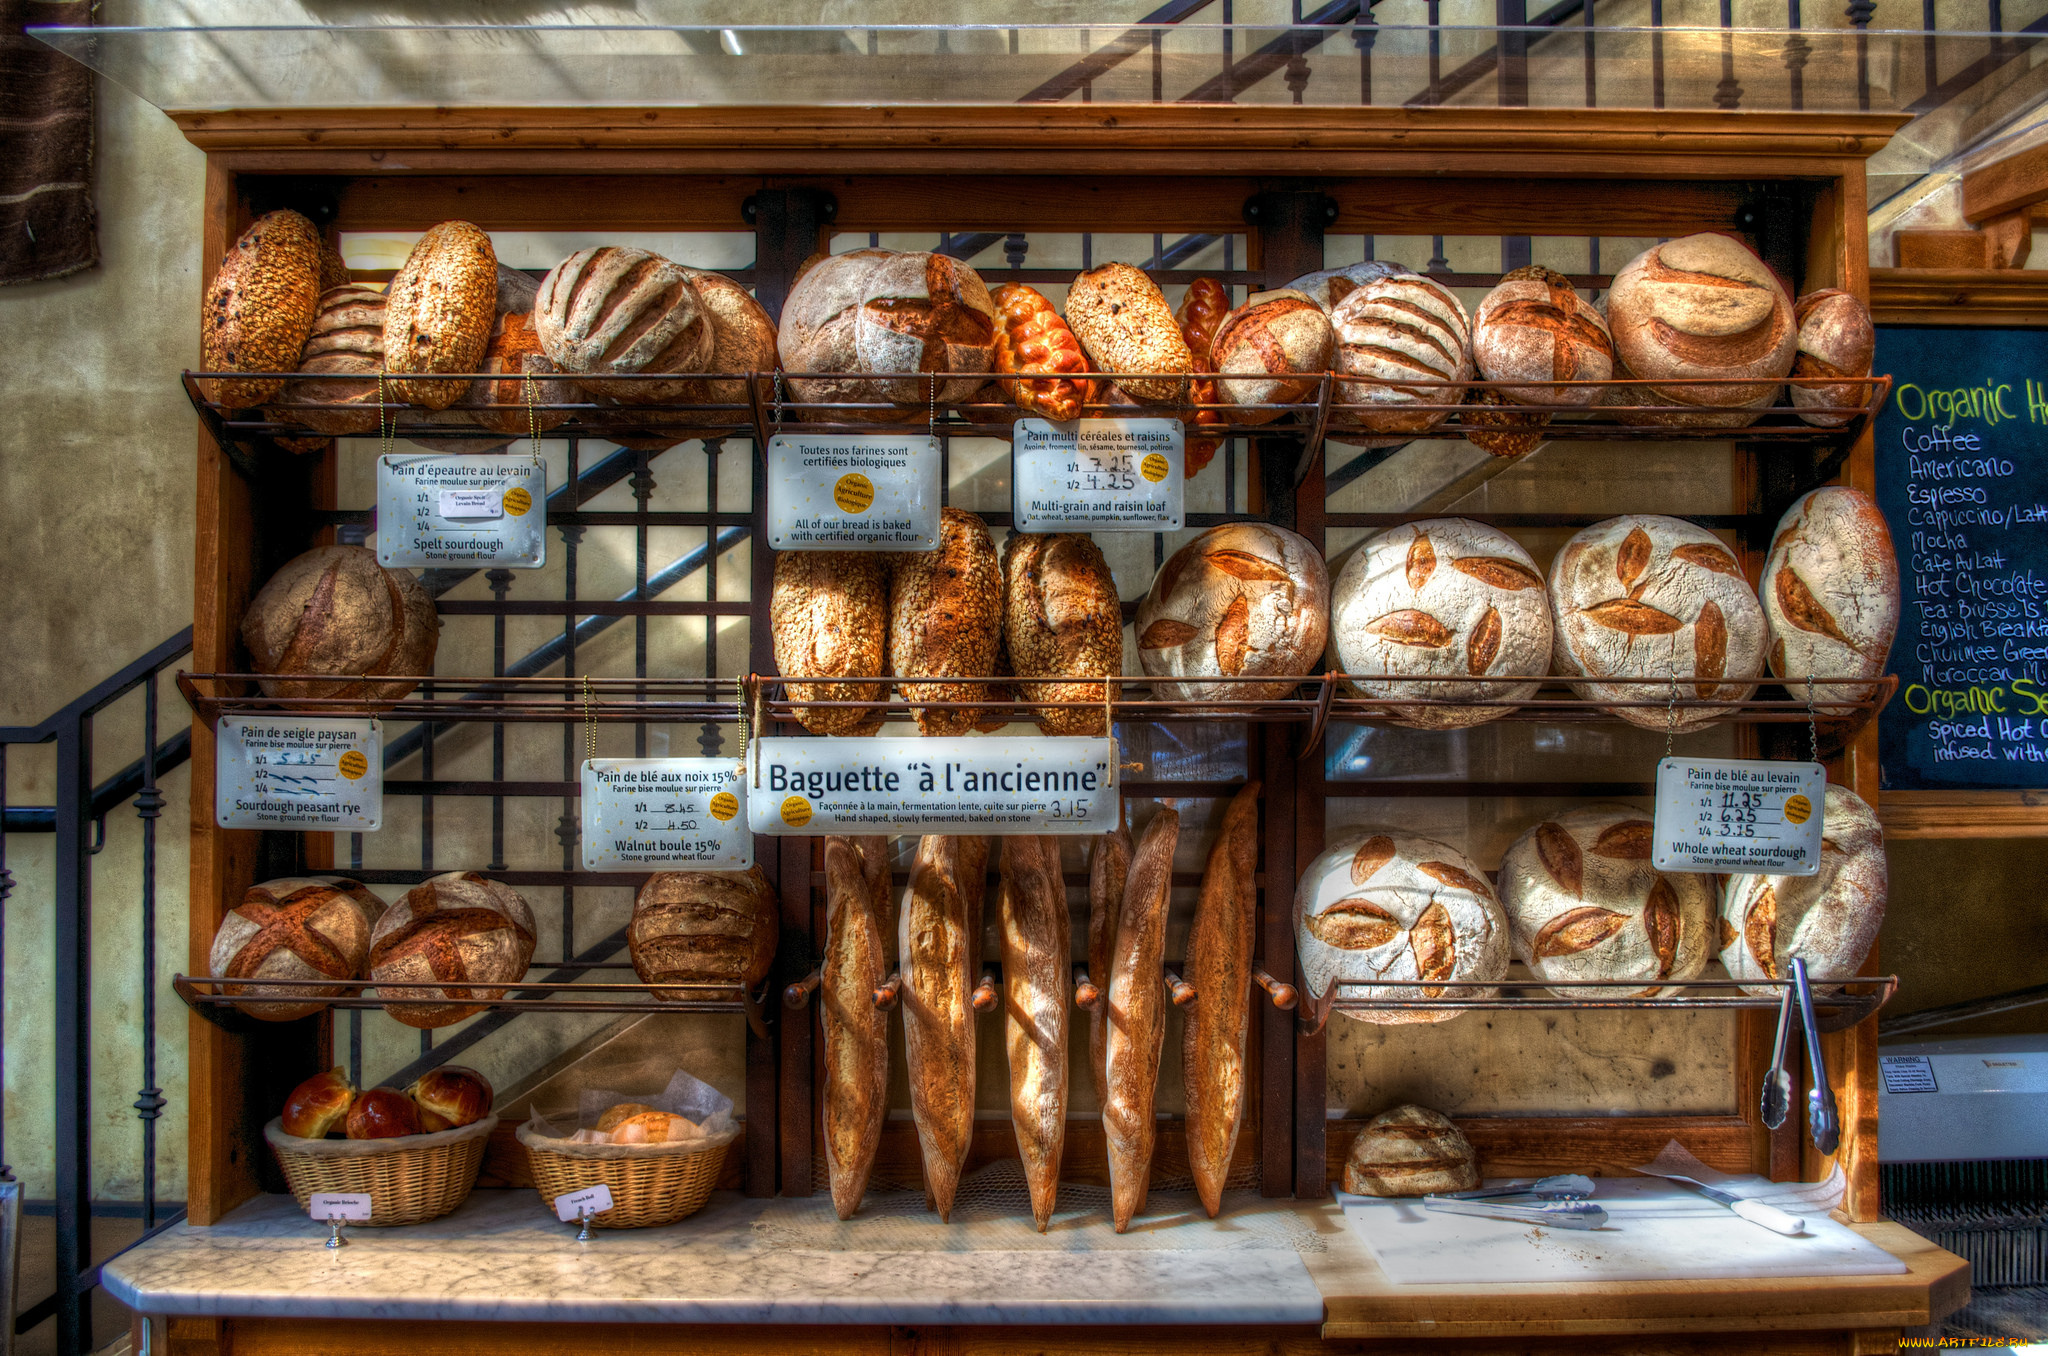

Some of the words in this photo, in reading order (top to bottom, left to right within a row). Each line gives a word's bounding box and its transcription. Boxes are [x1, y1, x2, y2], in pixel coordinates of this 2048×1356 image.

[1896, 377, 2016, 431] Organic
[1027, 432, 1048, 441] Pain
[1052, 432, 1077, 441] multi
[1080, 432, 1122, 441] céréales
[1125, 433, 1134, 441] et
[1138, 432, 1170, 441] raisins
[1902, 424, 1981, 452] Coffee
[800, 445, 830, 455] Toutes
[833, 447, 849, 455] nos
[852, 445, 885, 455] farines
[888, 447, 908, 455] sont
[803, 457, 848, 466] certifiées
[851, 457, 906, 469] biologiques
[1089, 455, 1135, 475] 7.25
[1909, 455, 2014, 480] Americano
[392, 465, 414, 475] Pain
[418, 465, 476, 478] d'épeautre
[497, 465, 530, 476] levain
[846, 479, 868, 489] Organic
[1087, 474, 1135, 490] 4.25
[417, 494, 429, 502] 1/1
[837, 487, 872, 500] Agriculture
[1907, 483, 1987, 510] Espresso
[417, 509, 430, 517] 1/2
[1032, 501, 1089, 513] Multi-grain
[1093, 501, 1111, 511] and
[1115, 501, 1143, 511] raisin
[1146, 501, 1166, 511] loaf
[1092, 514, 1121, 522] pumpkin,
[417, 523, 430, 531] 1/4
[796, 520, 808, 529] All
[812, 520, 821, 529] of
[843, 520, 869, 529] bread
[883, 520, 911, 529] baked
[791, 531, 812, 541] with
[815, 531, 855, 541] certified
[857, 532, 893, 543] organic
[896, 532, 918, 541] flour
[1911, 531, 1967, 554] Mocha
[414, 539, 442, 550] Spelt
[445, 539, 503, 552] sourdough
[449, 552, 475, 561] ground
[1911, 554, 1952, 572] Cafe
[1975, 549, 2006, 569] Lait
[1916, 573, 1950, 597] Hot
[1956, 569, 2047, 601] Chocolate
[1921, 618, 1978, 646] English
[1922, 664, 2016, 686] Moroccan
[1905, 680, 2006, 721] Organic
[241, 727, 264, 738] Pain
[268, 727, 279, 738] de
[283, 728, 315, 740] seigle
[318, 729, 356, 741] paysan
[1928, 716, 1992, 744] Spiced
[1998, 717, 2034, 741] Hot
[246, 740, 268, 748] Farine
[270, 740, 285, 748] bise
[1933, 740, 1997, 762] infused
[255, 755, 267, 764] 1/1
[255, 770, 268, 778] 1/2
[597, 772, 620, 782] Pain
[624, 772, 637, 782] de
[640, 771, 657, 782] blé
[661, 773, 681, 782] aux
[685, 772, 708, 782] noix
[713, 771, 737, 783] 15%
[1688, 768, 1711, 780] Pain
[1715, 770, 1728, 780] de
[1731, 770, 1748, 781] blé
[1751, 772, 1763, 782] au
[1767, 771, 1800, 783] levain
[770, 764, 899, 799] Baguette
[255, 784, 268, 792] 1/4
[699, 785, 721, 794] pierre
[1690, 782, 1713, 790] Farine
[1732, 784, 1760, 792] moulue
[1775, 785, 1797, 794] pierre
[1700, 797, 1712, 806] 1/1
[1722, 793, 1762, 808] 11.25
[236, 800, 293, 814] Sourdough
[297, 802, 340, 814] peasant
[342, 803, 360, 815] rye
[635, 802, 647, 812] 1/1
[819, 802, 858, 812] Façonnée
[878, 802, 900, 812] main,
[902, 802, 956, 810] fermentation
[959, 802, 982, 812] lente,
[984, 802, 1003, 810] cuite
[1021, 803, 1046, 812] pierre
[1051, 799, 1088, 818] 3.15
[257, 813, 277, 821] Stone
[280, 814, 306, 822] ground
[321, 814, 339, 822] flour
[835, 814, 856, 822] Hand
[859, 814, 891, 823] shaped,
[892, 814, 919, 824] slowly
[922, 814, 967, 823] fermented,
[969, 814, 994, 822] baked
[1700, 812, 1712, 821] 1/2
[1721, 808, 1756, 822] 6.25
[635, 820, 648, 829] 1/2
[1699, 827, 1711, 836] 1/4
[615, 841, 656, 851] Walnut
[660, 841, 691, 851] boule
[695, 840, 720, 852] 15%
[1672, 842, 1708, 854] Whole
[1712, 843, 1745, 856] wheat
[1749, 845, 1806, 861] sourdough
[644, 854, 670, 862] ground
[1692, 856, 1713, 864] Stone
[1715, 857, 1740, 866] ground
[1743, 858, 1765, 866] wheat
[1767, 858, 1785, 867] flour
